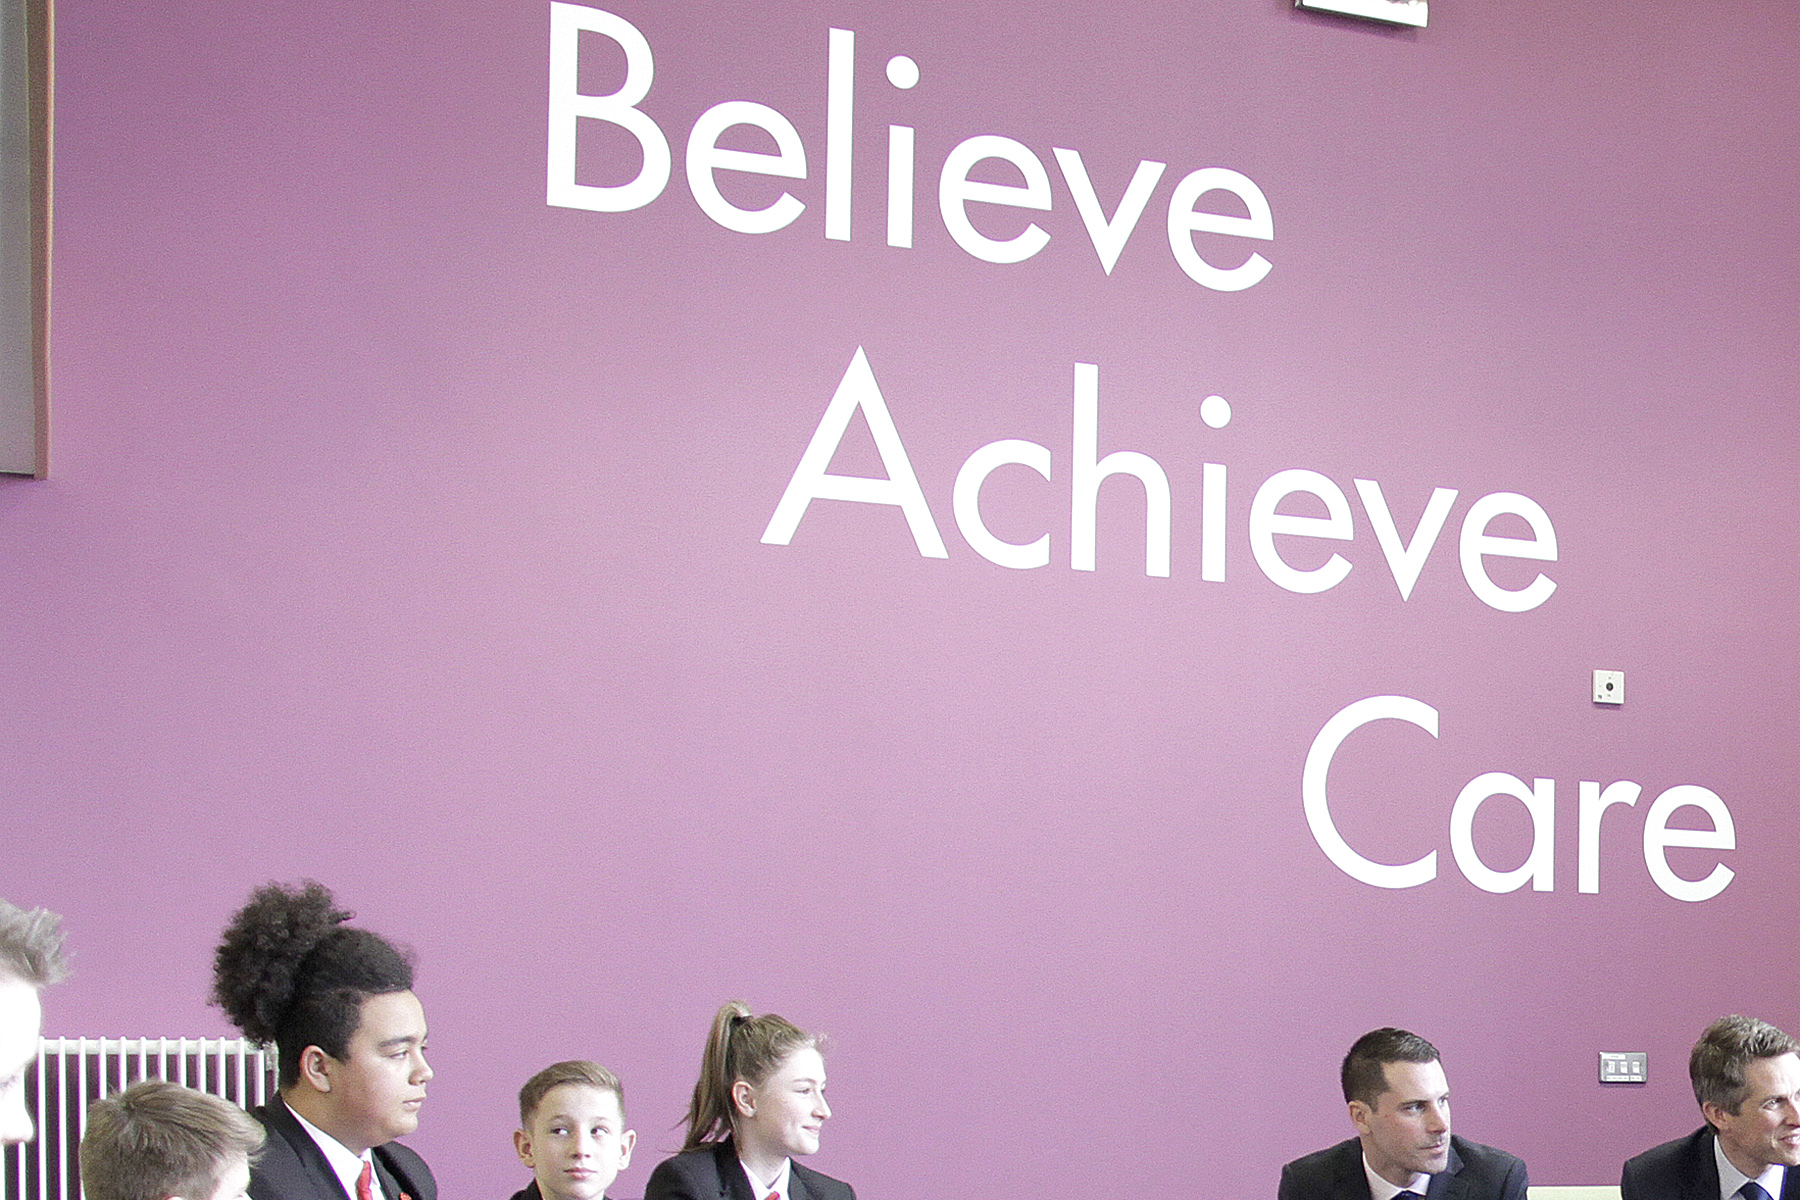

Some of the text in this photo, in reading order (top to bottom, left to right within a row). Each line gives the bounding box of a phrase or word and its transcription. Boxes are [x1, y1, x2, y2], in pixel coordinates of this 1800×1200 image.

[546, 1, 1274, 292] Believe
[759, 344, 1559, 613] Achieve
[1302, 695, 1736, 902] Care
